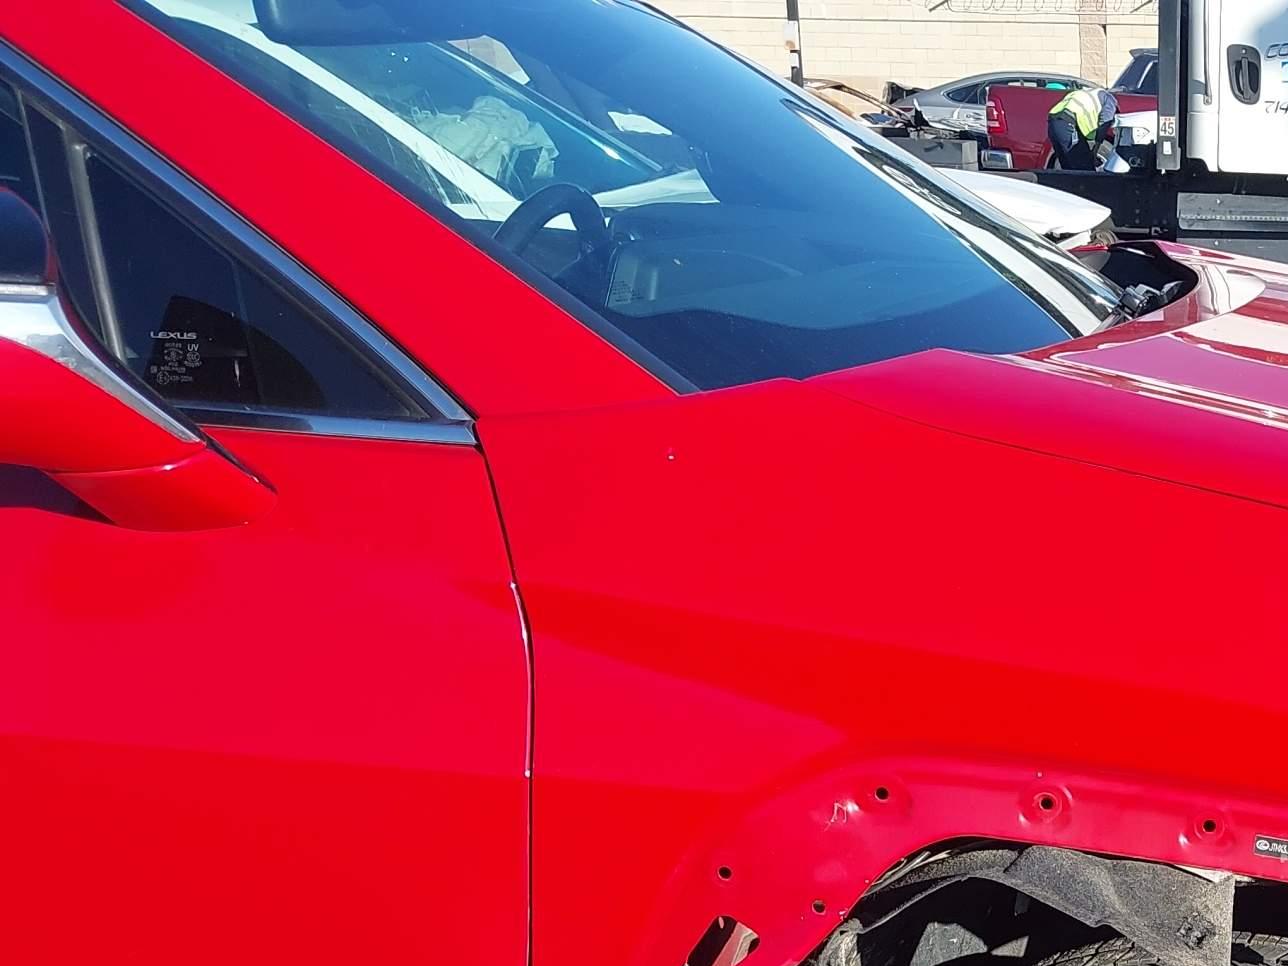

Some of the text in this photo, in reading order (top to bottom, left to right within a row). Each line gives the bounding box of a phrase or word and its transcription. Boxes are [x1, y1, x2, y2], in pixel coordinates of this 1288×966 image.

[1160, 121, 1175, 136] 45
[150, 331, 198, 340] LEXUS
[187, 343, 200, 352] UV
